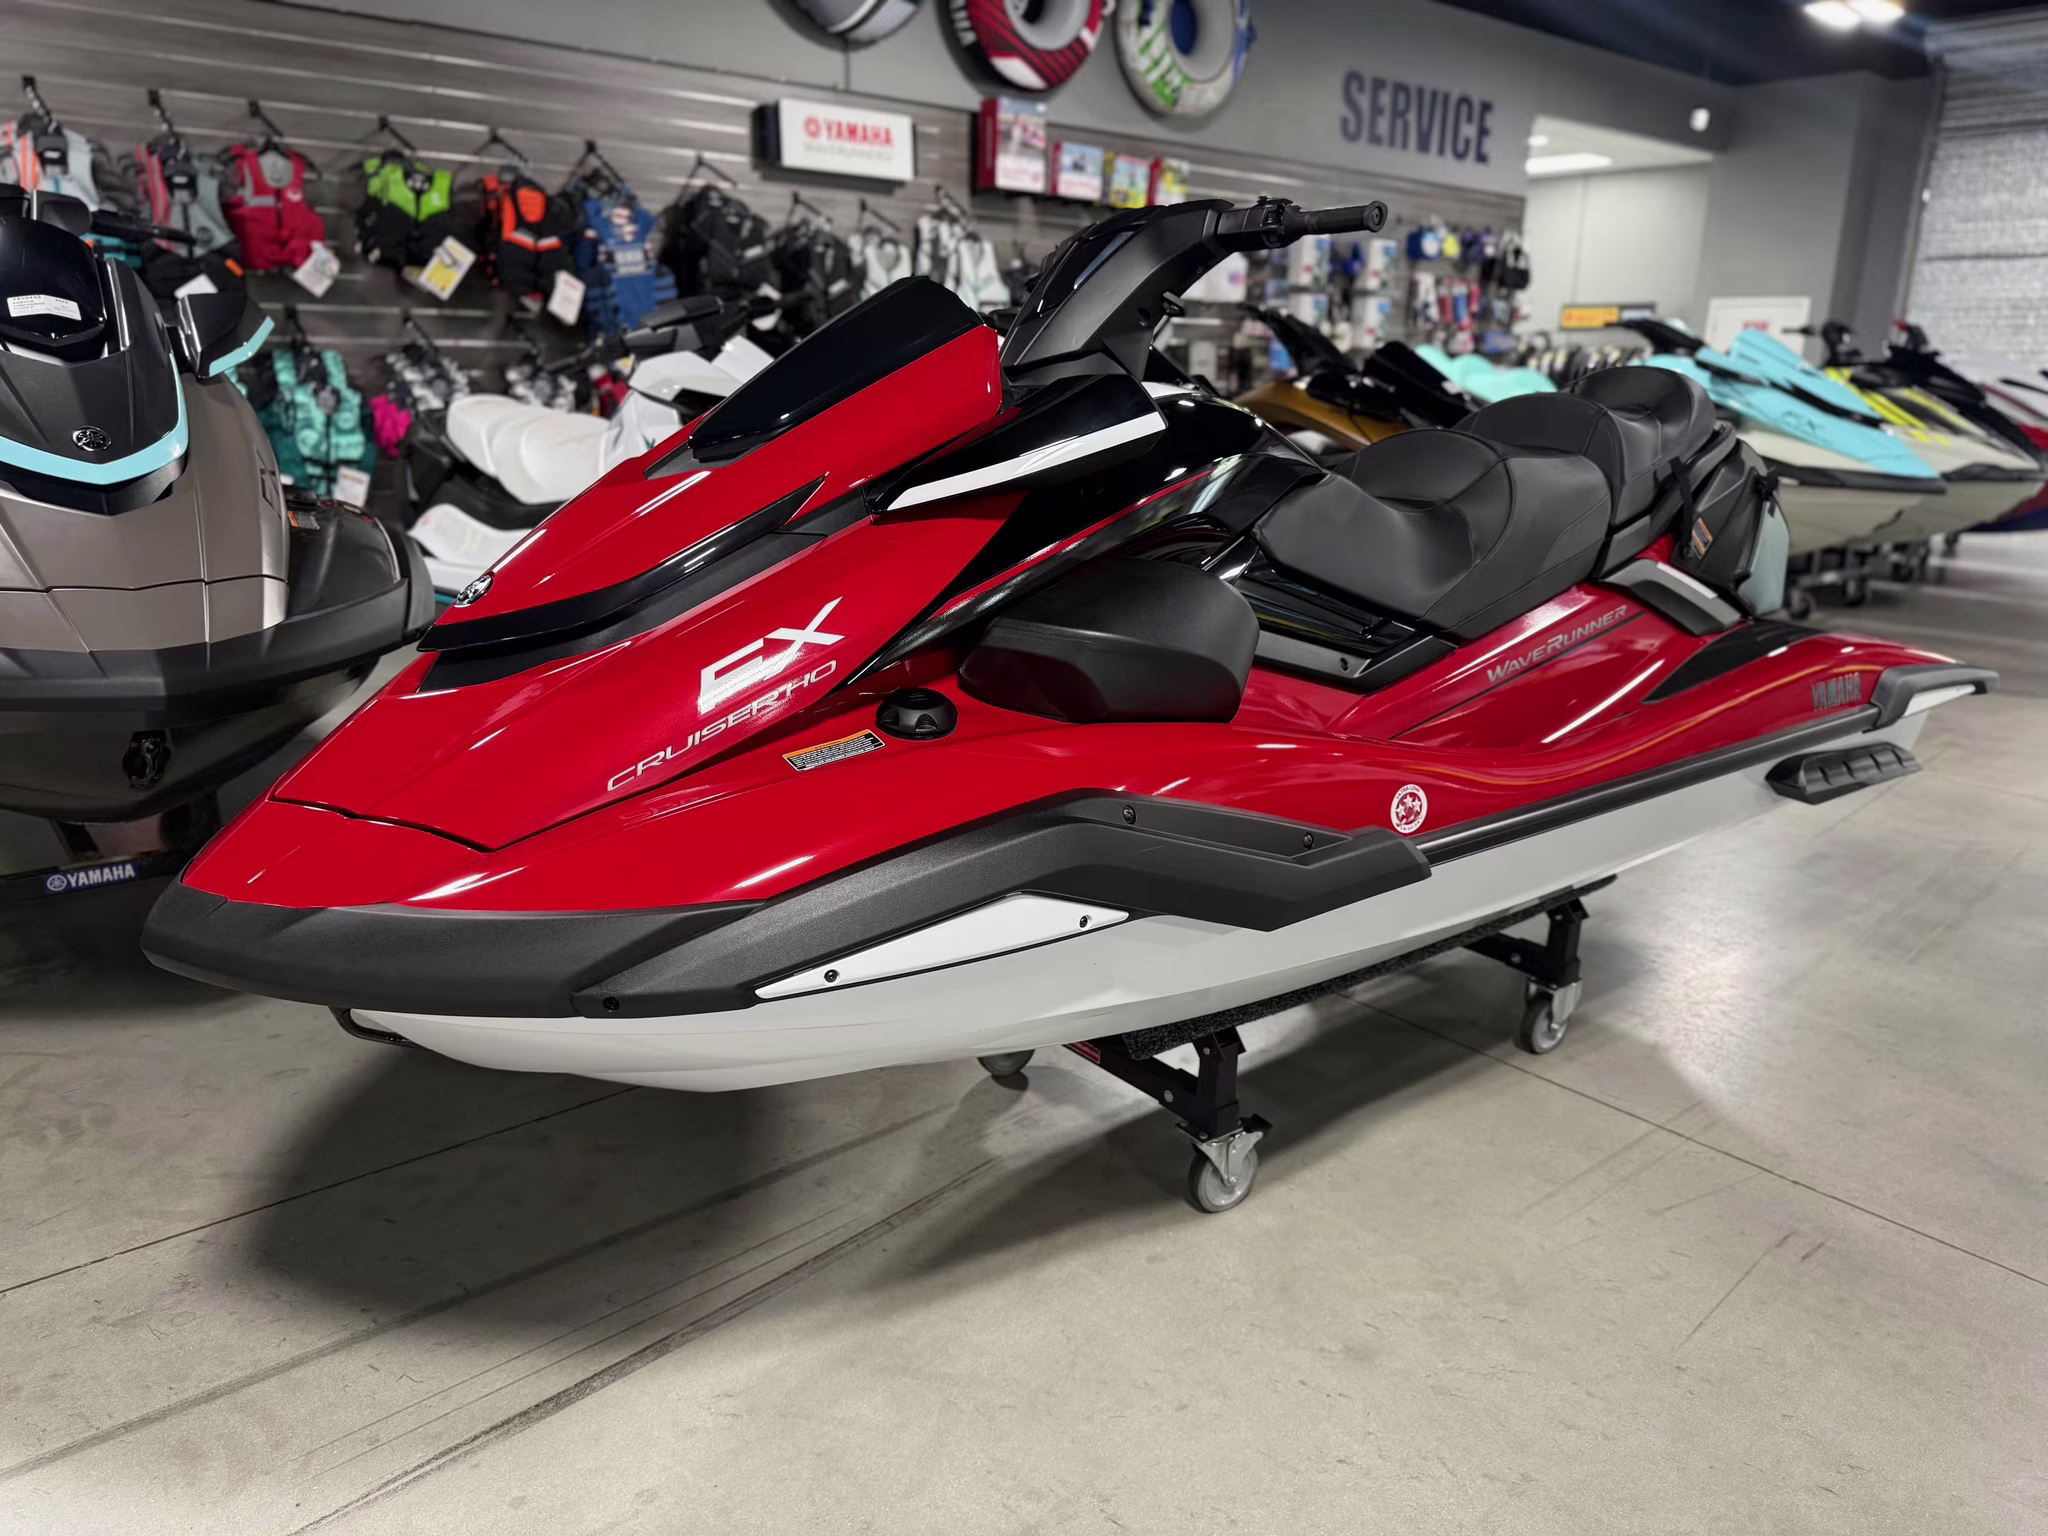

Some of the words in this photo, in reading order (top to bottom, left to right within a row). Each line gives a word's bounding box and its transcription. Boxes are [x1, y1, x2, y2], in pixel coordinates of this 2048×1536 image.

[824, 119, 894, 148] YAMAHA
[1340, 69, 1493, 165] SERVICE
[1811, 671, 1862, 713] YAMAHA
[607, 689, 781, 792] CRUISER
[66, 863, 135, 888] YAMAHA
